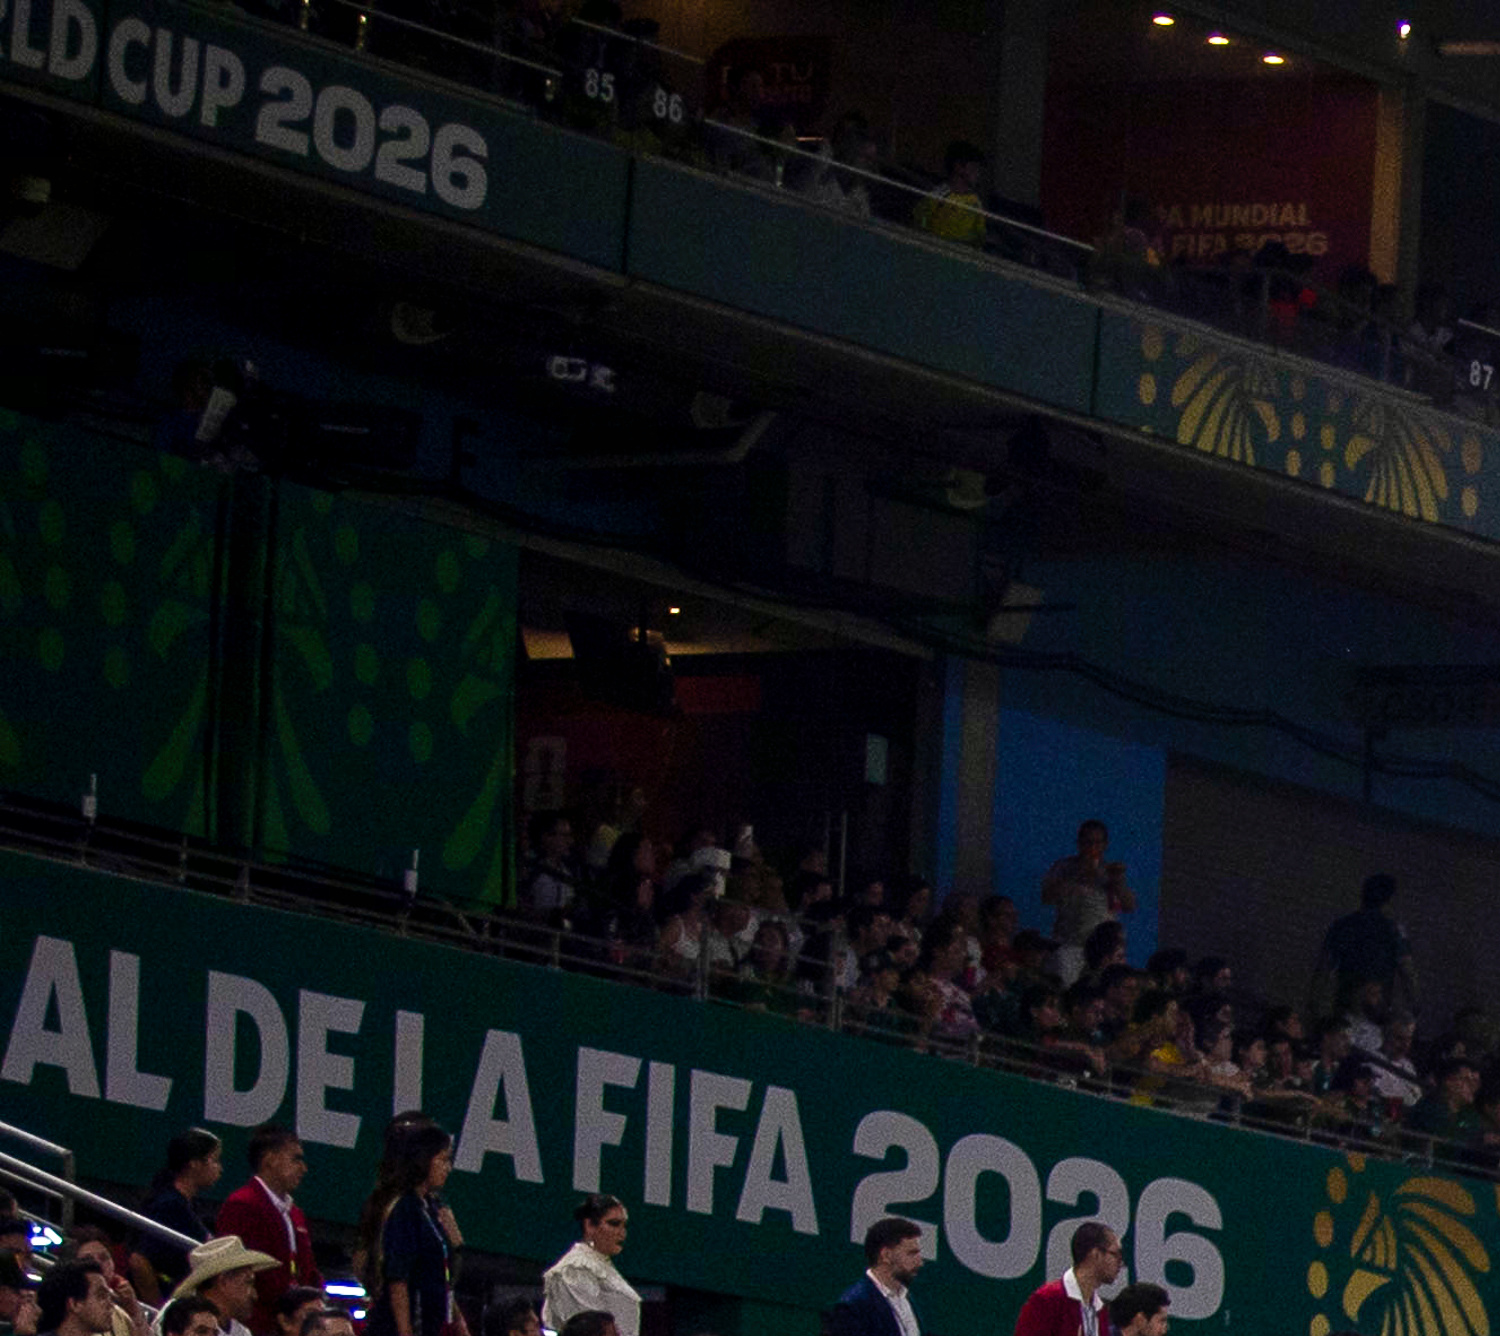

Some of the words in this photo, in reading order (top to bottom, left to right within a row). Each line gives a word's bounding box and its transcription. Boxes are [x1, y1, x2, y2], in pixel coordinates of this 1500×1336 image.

[583, 66, 615, 103] 85
[0, 0, 99, 82] LD
[106, 17, 245, 129] CUP
[254, 65, 489, 211] 2026
[652, 87, 685, 124] 86
[1191, 202, 1311, 228] MUNDIAL
[1468, 359, 1494, 390] 87
[203, 968, 367, 1150] DE
[572, 1044, 820, 1236] FIFA
[848, 1108, 1226, 1321] 2026
